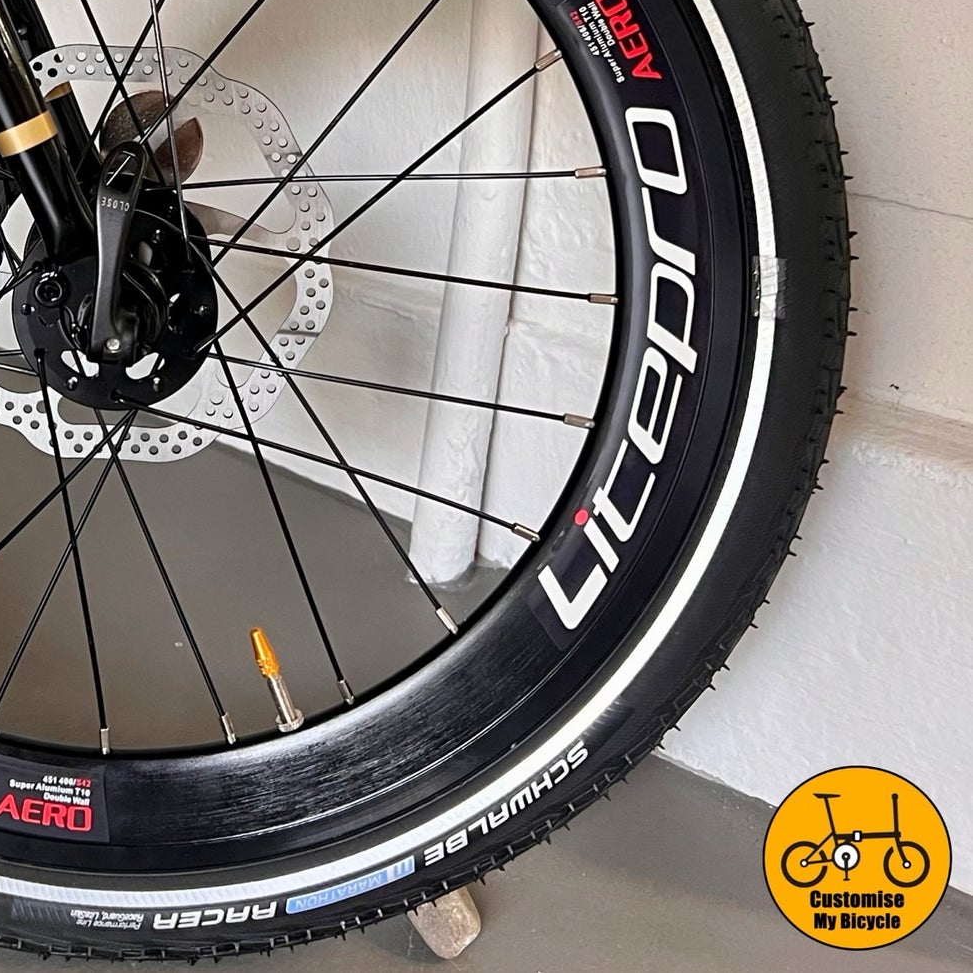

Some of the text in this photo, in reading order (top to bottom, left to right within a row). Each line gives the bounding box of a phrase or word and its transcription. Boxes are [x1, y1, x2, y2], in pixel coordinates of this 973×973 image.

[578, 6, 592, 23] T10
[587, 1, 616, 47] Double Wall
[608, 58, 625, 84] Super
[101, 196, 130, 212] CLOSE
[538, 106, 697, 630] Litepro
[9, 779, 34, 790] Super
[75, 787, 91, 797] T10
[42, 775, 57, 784] 451
[43, 792, 90, 806] Double Wall
[424, 740, 588, 867] SCHWALBE
[291, 871, 384, 909] MARATHON
[76, 919, 142, 930] Performance Line
[152, 901, 277, 930] RACER
